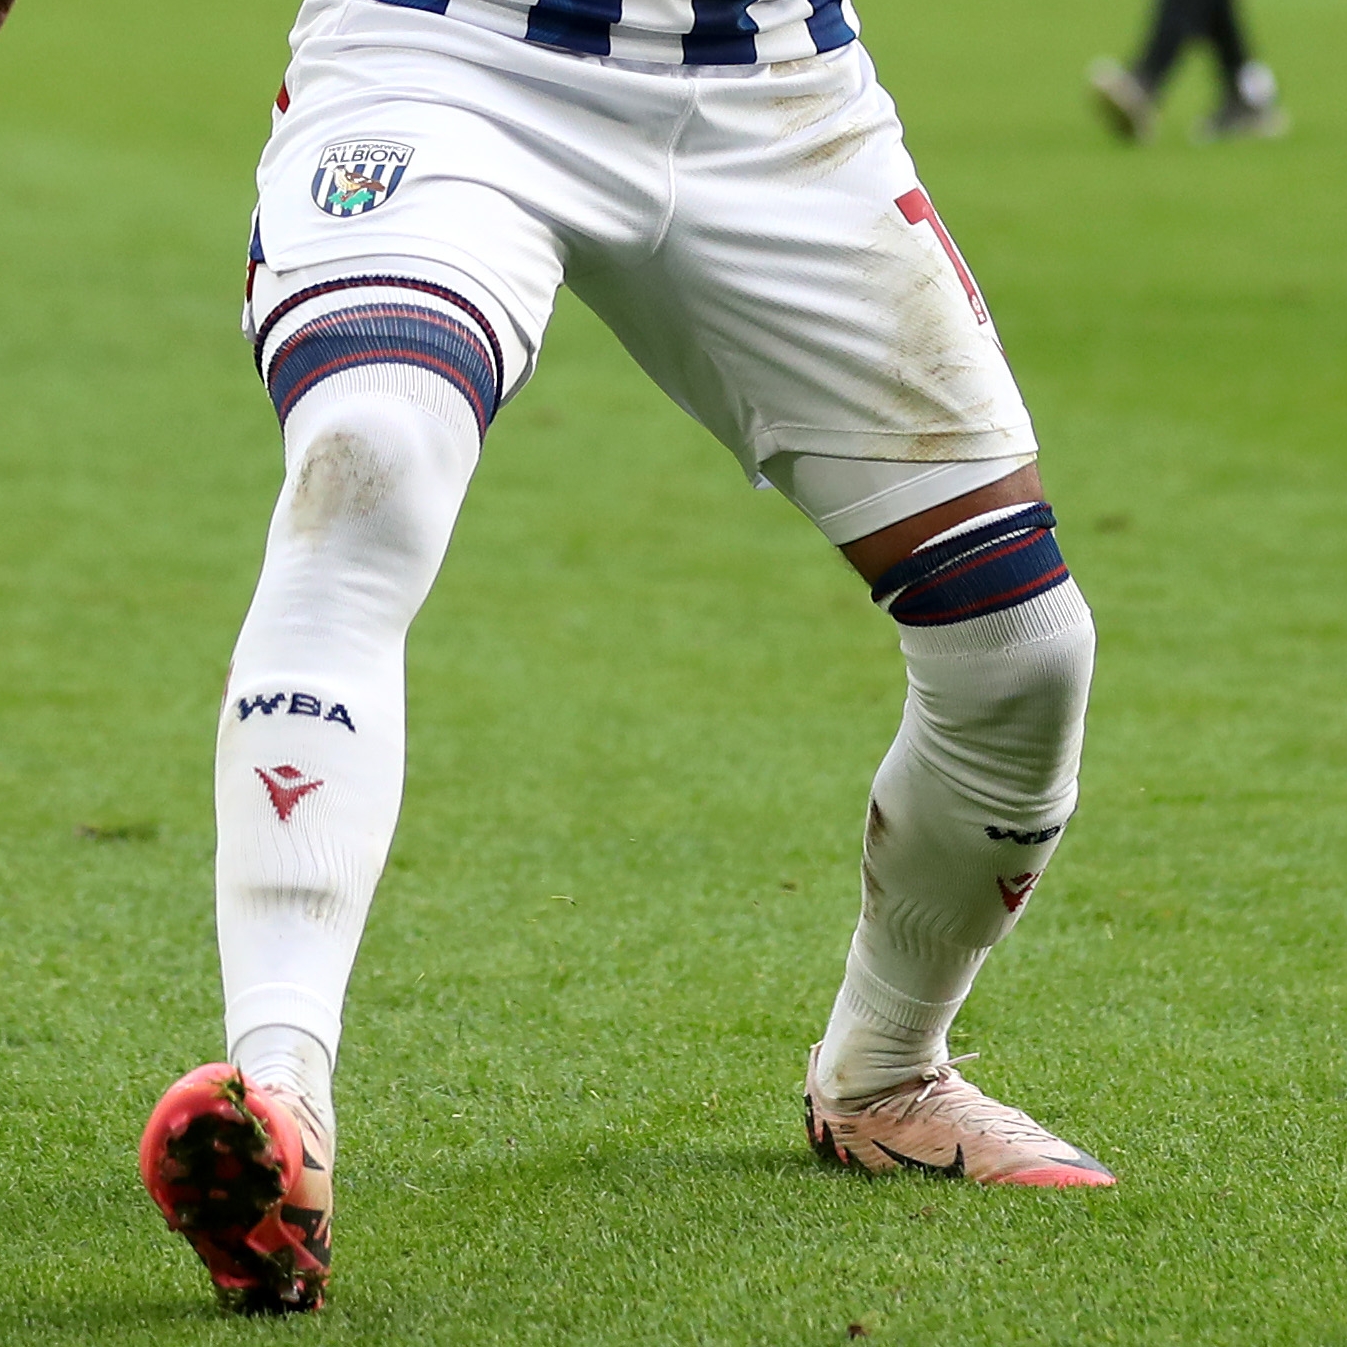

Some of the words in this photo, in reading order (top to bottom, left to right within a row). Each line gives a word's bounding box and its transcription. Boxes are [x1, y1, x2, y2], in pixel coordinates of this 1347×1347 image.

[324, 150, 406, 165] ALBION
[238, 692, 356, 733] WBA
[984, 825, 1061, 845] WB
